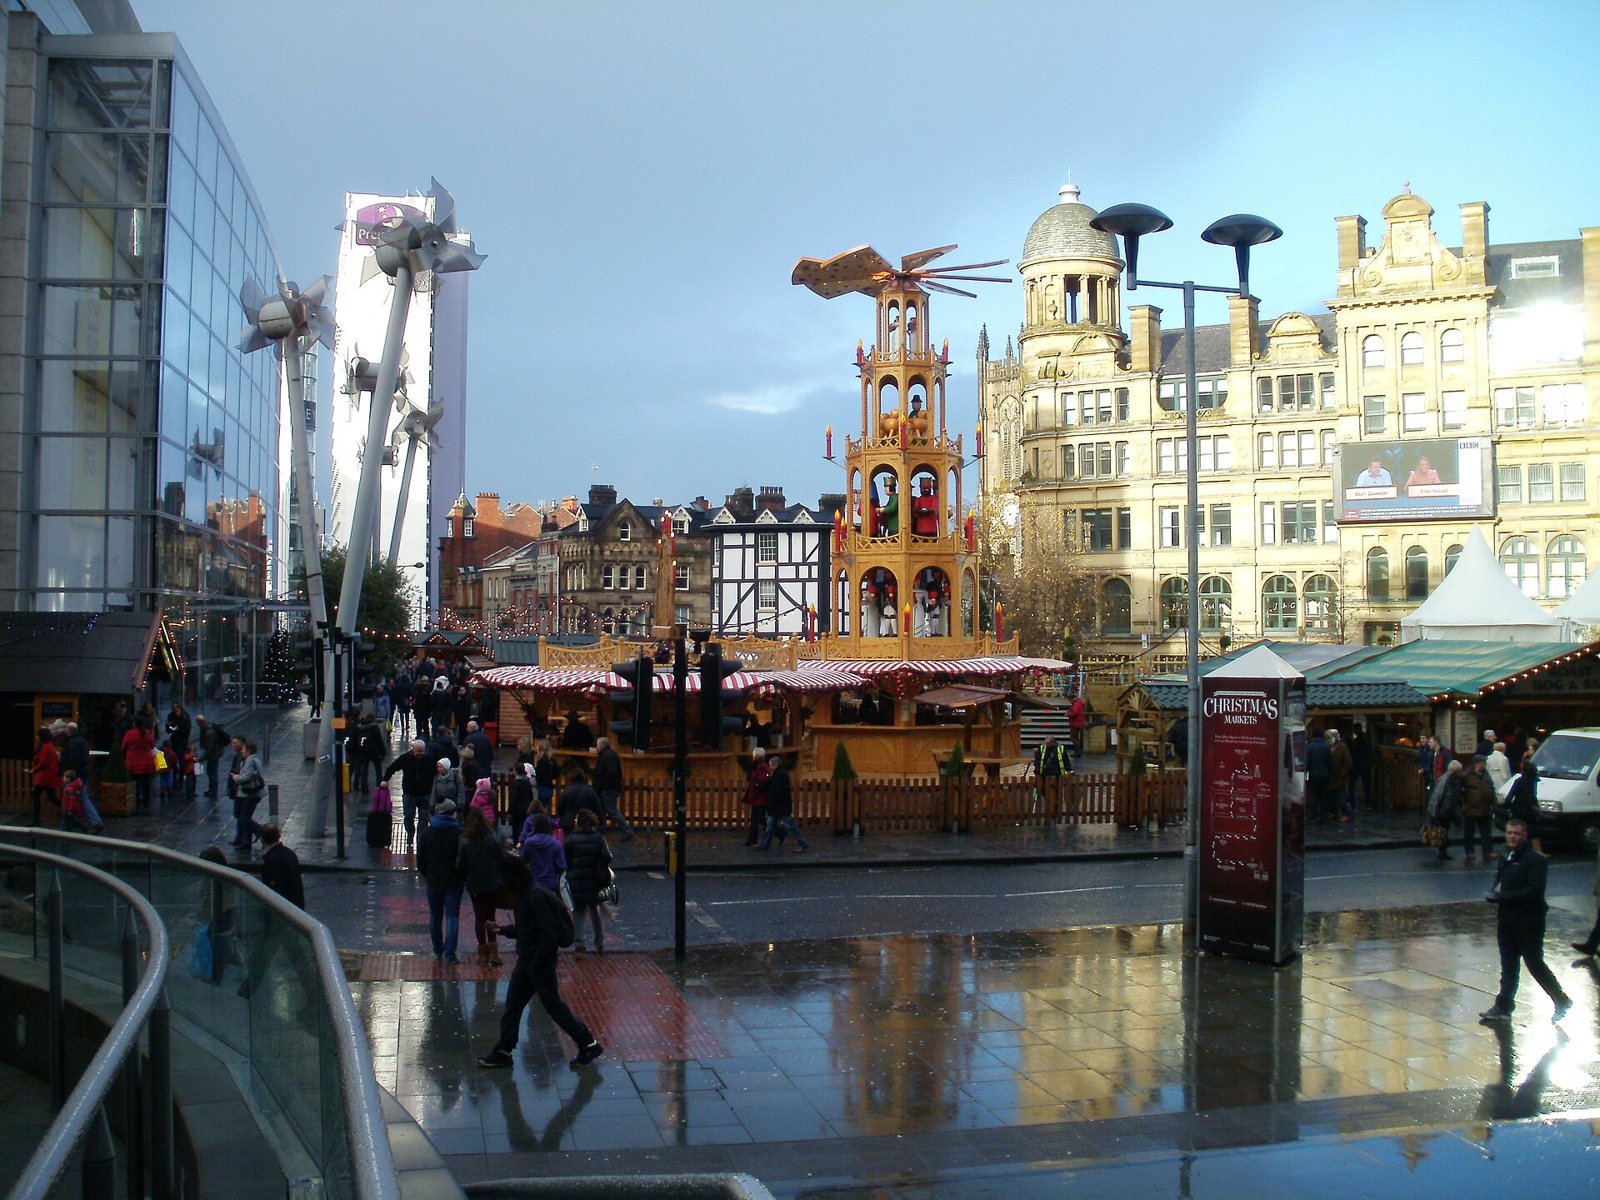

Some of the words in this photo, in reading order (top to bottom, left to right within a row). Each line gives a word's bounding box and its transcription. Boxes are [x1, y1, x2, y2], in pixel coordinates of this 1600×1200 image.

[1459, 441, 1479, 449] BBC
[1532, 678, 1564, 691] HOG
[1203, 697, 1278, 720] CHRISTMAS
[1224, 715, 1258, 725] MARKETS
